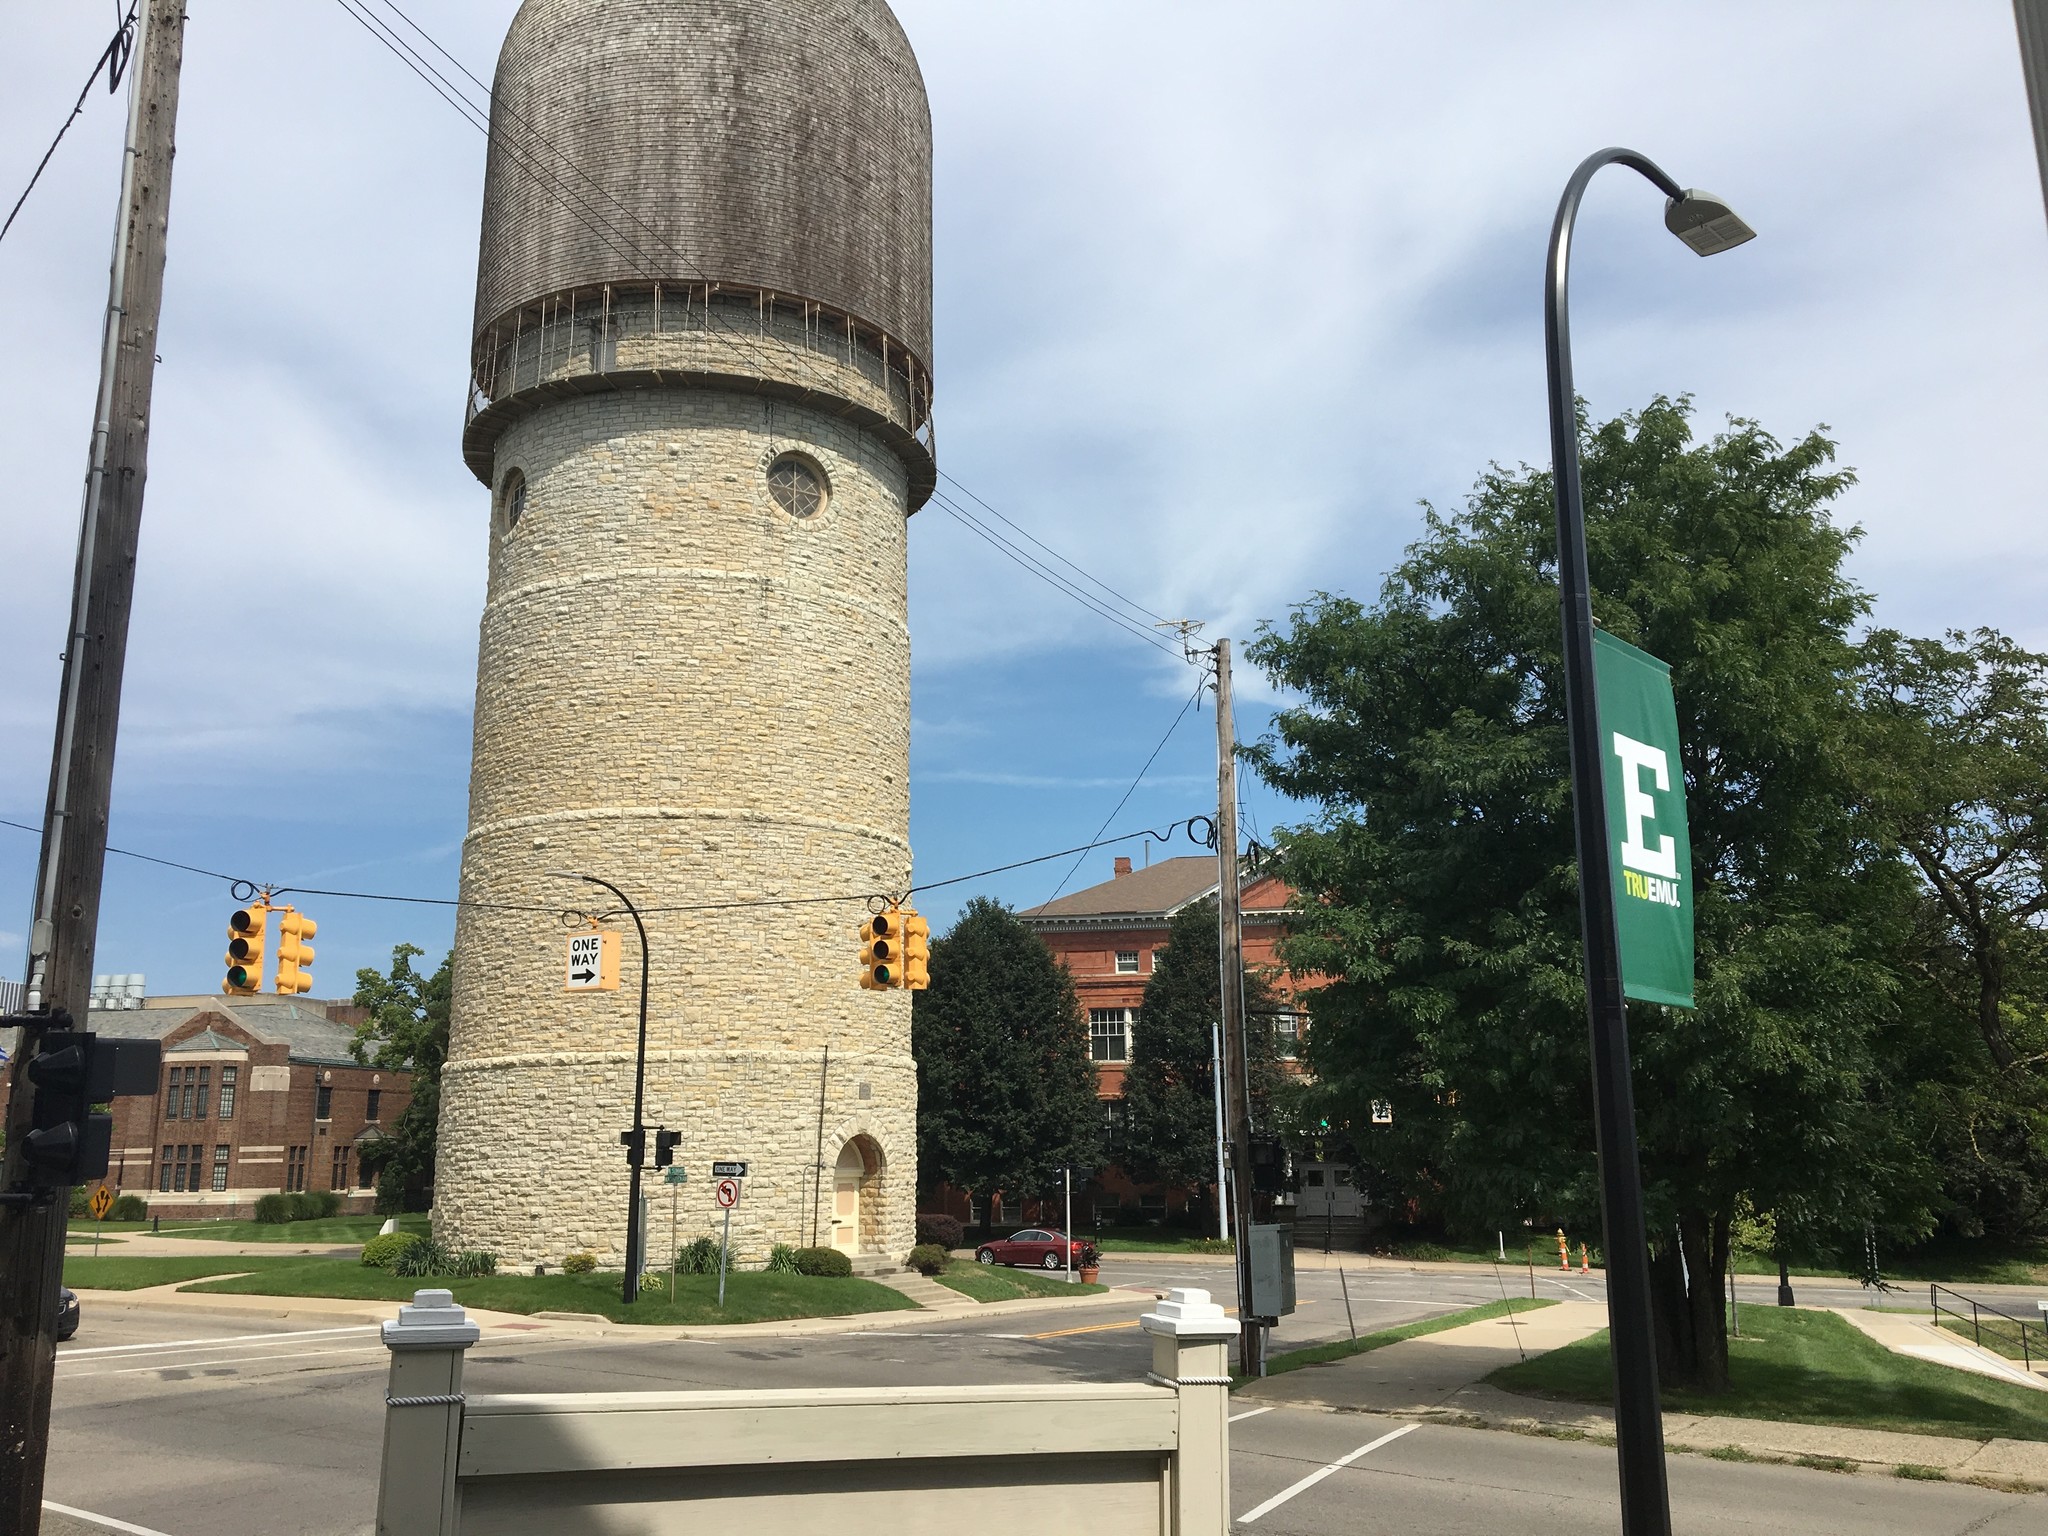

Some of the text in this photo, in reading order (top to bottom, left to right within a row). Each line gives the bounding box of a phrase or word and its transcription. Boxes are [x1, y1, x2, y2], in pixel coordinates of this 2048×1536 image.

[1613, 731, 1676, 879] E
[572, 938, 599, 952] ONE
[571, 952, 599, 967] WAY
